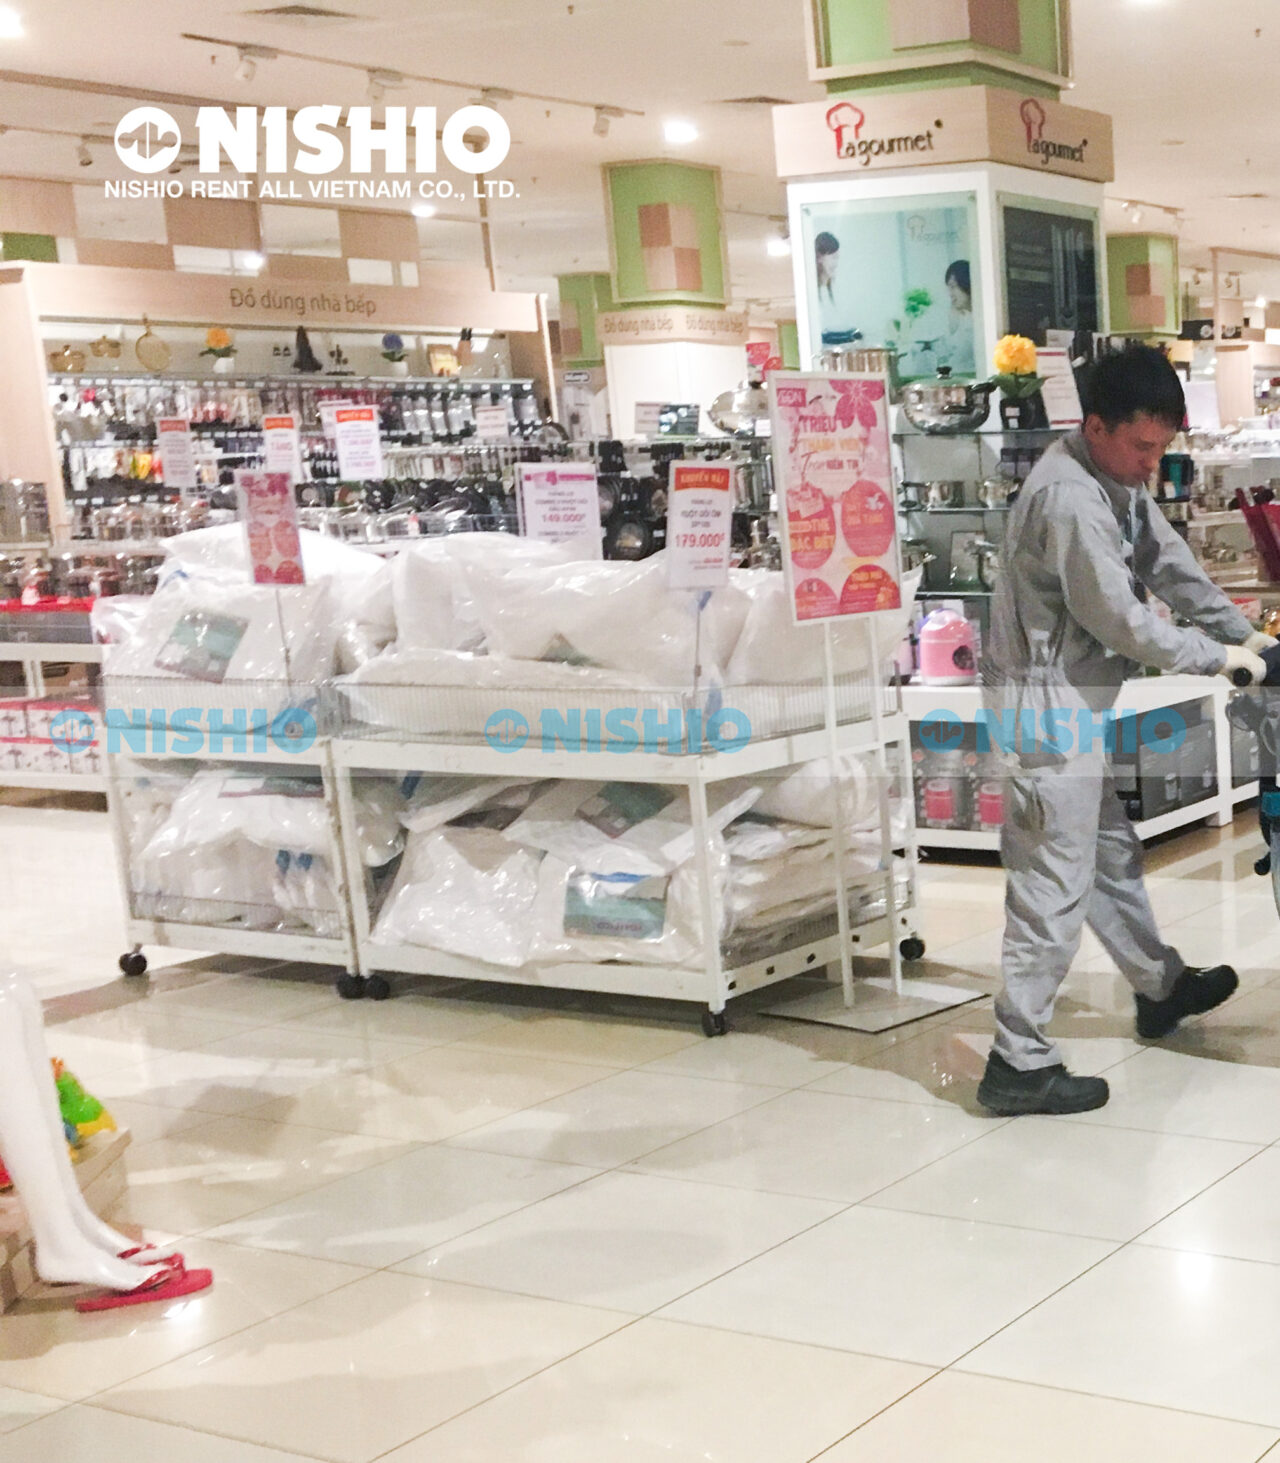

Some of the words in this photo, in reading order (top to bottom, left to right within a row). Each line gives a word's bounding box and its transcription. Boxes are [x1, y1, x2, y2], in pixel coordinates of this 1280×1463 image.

[229, 287, 256, 308] Đồ
[260, 288, 306, 316] dùng
[310, 292, 339, 313] nhà
[344, 290, 377, 317] bếp
